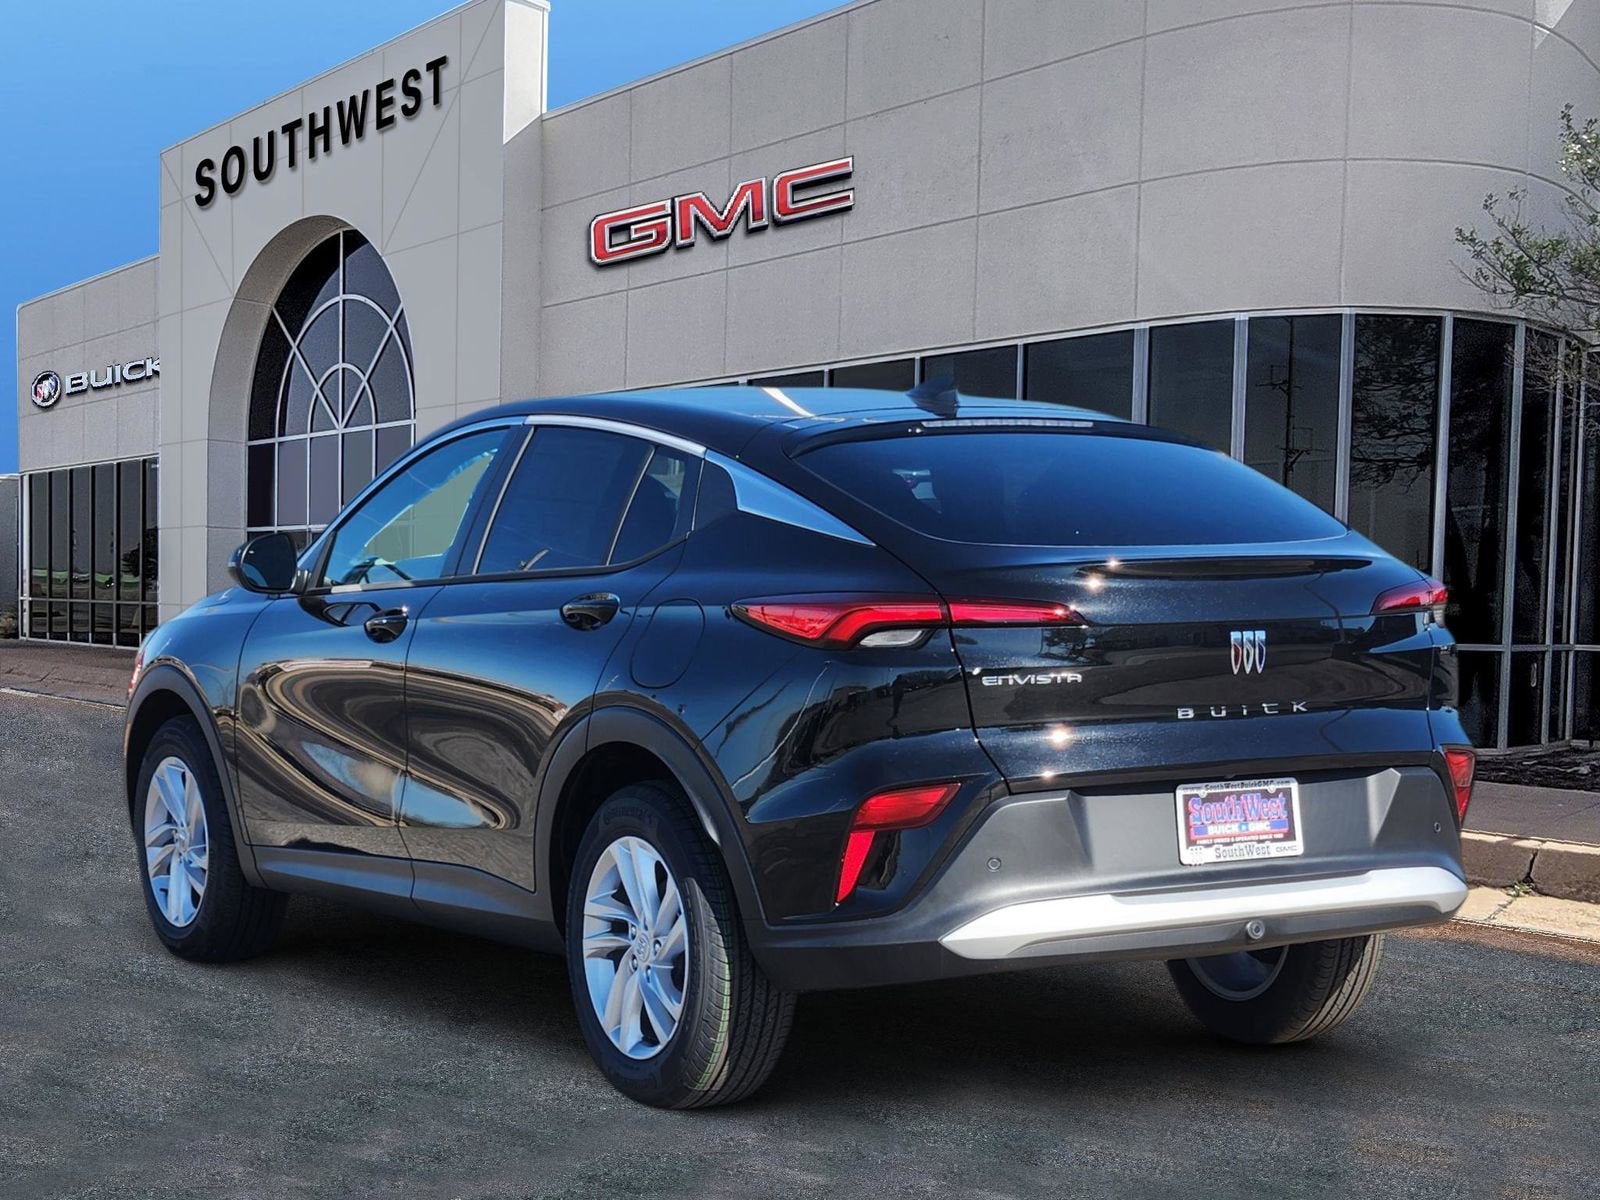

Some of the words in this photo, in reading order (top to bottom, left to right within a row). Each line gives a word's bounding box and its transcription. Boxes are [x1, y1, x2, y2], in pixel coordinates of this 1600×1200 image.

[194, 55, 448, 208] SOUTHWEST
[589, 155, 855, 266] GMC
[64, 358, 160, 396] BUICK
[982, 673, 1082, 686] ENVISTA
[1177, 701, 1308, 719] BUICK
[1188, 792, 1288, 825] SouthWest
[1207, 823, 1239, 836] BUICK
[1248, 821, 1271, 832] GMC
[1214, 842, 1272, 859] SouthWest
